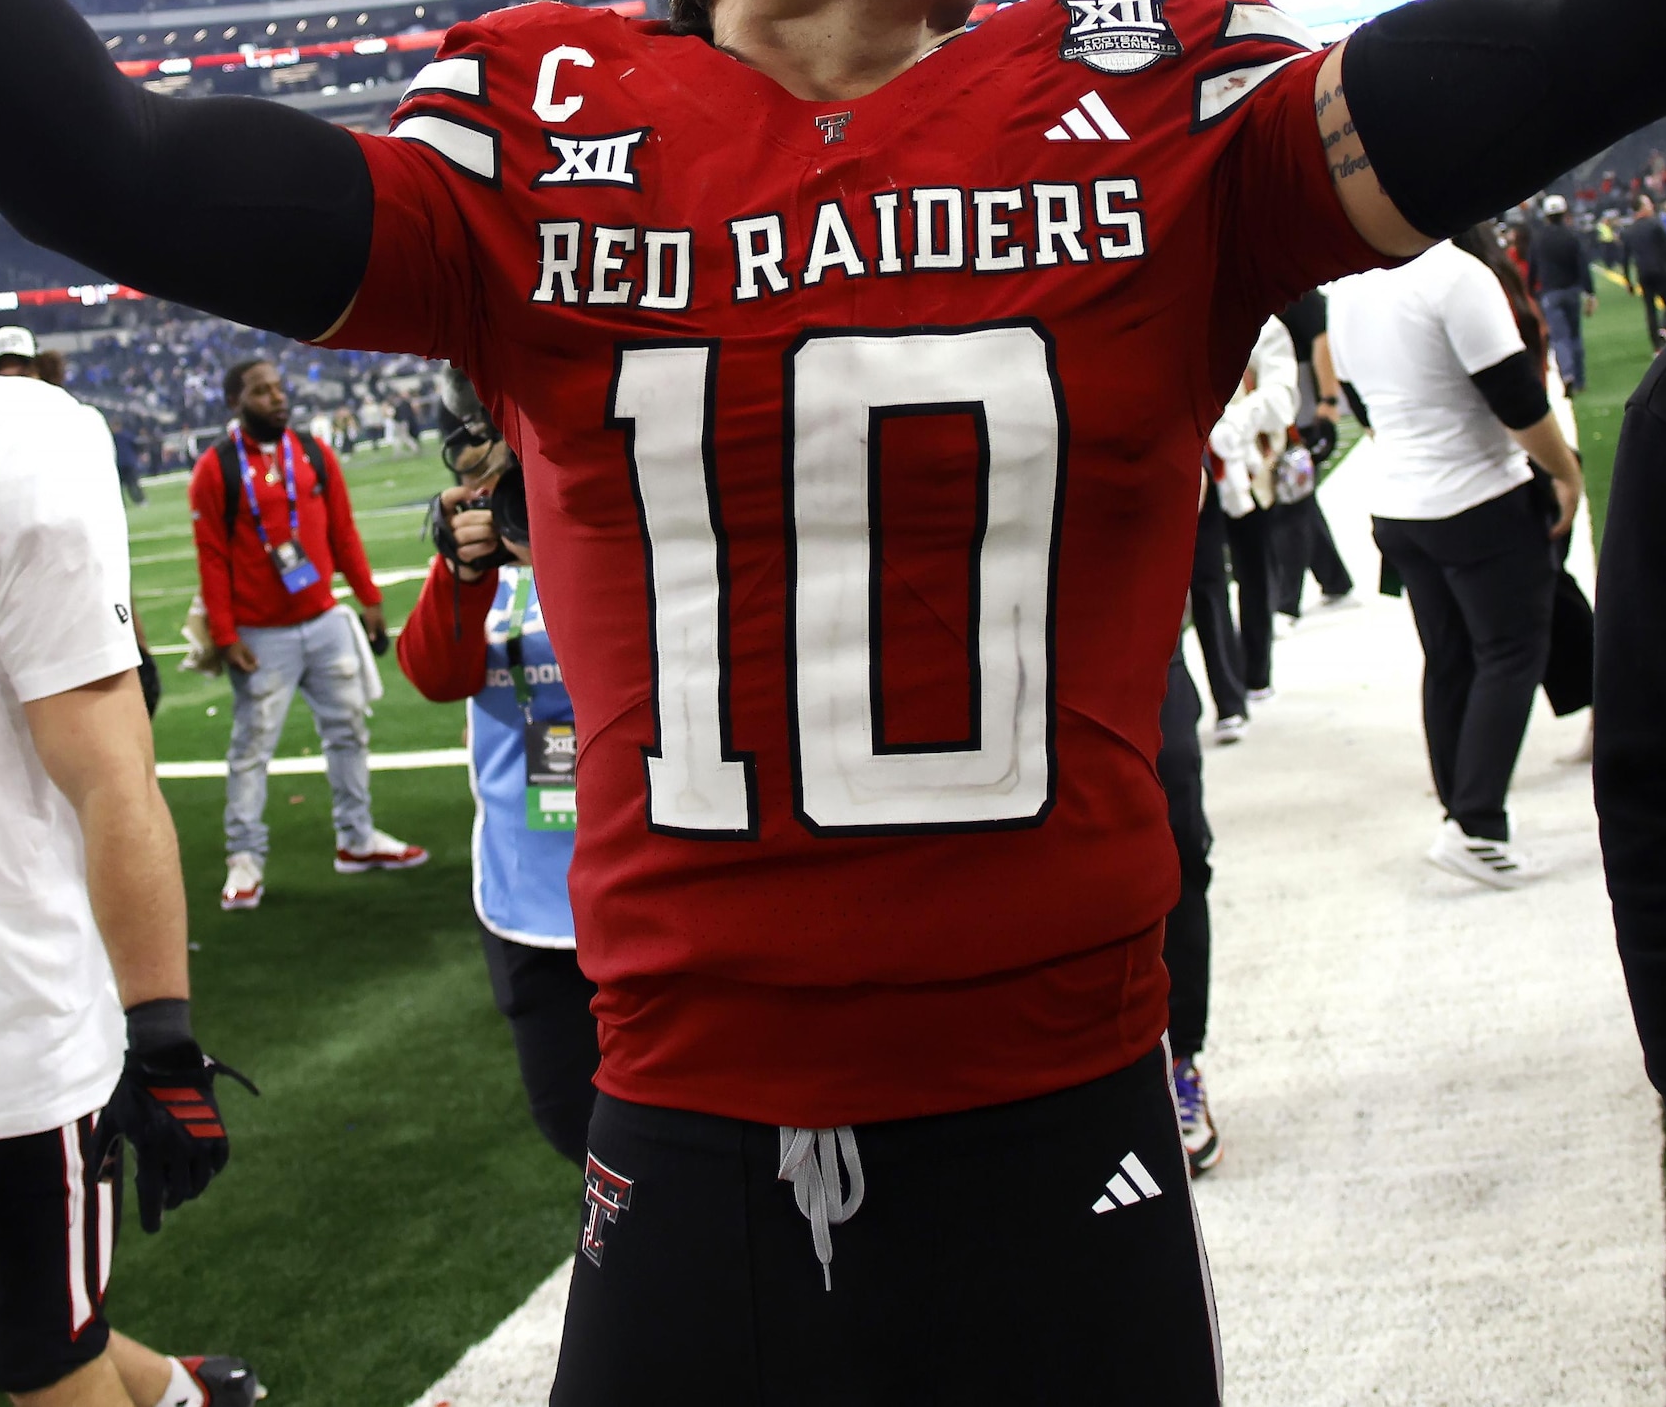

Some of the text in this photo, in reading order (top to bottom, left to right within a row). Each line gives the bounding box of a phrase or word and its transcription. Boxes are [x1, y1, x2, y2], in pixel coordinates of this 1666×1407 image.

[1063, 41, 1177, 57] CHAMPIONSHIP
[1083, 35, 1156, 47] FOOTBALL
[532, 44, 595, 123] C
[538, 132, 644, 185] XII
[531, 178, 1146, 310] RED RAIDERS
[613, 327, 1060, 832] 10
